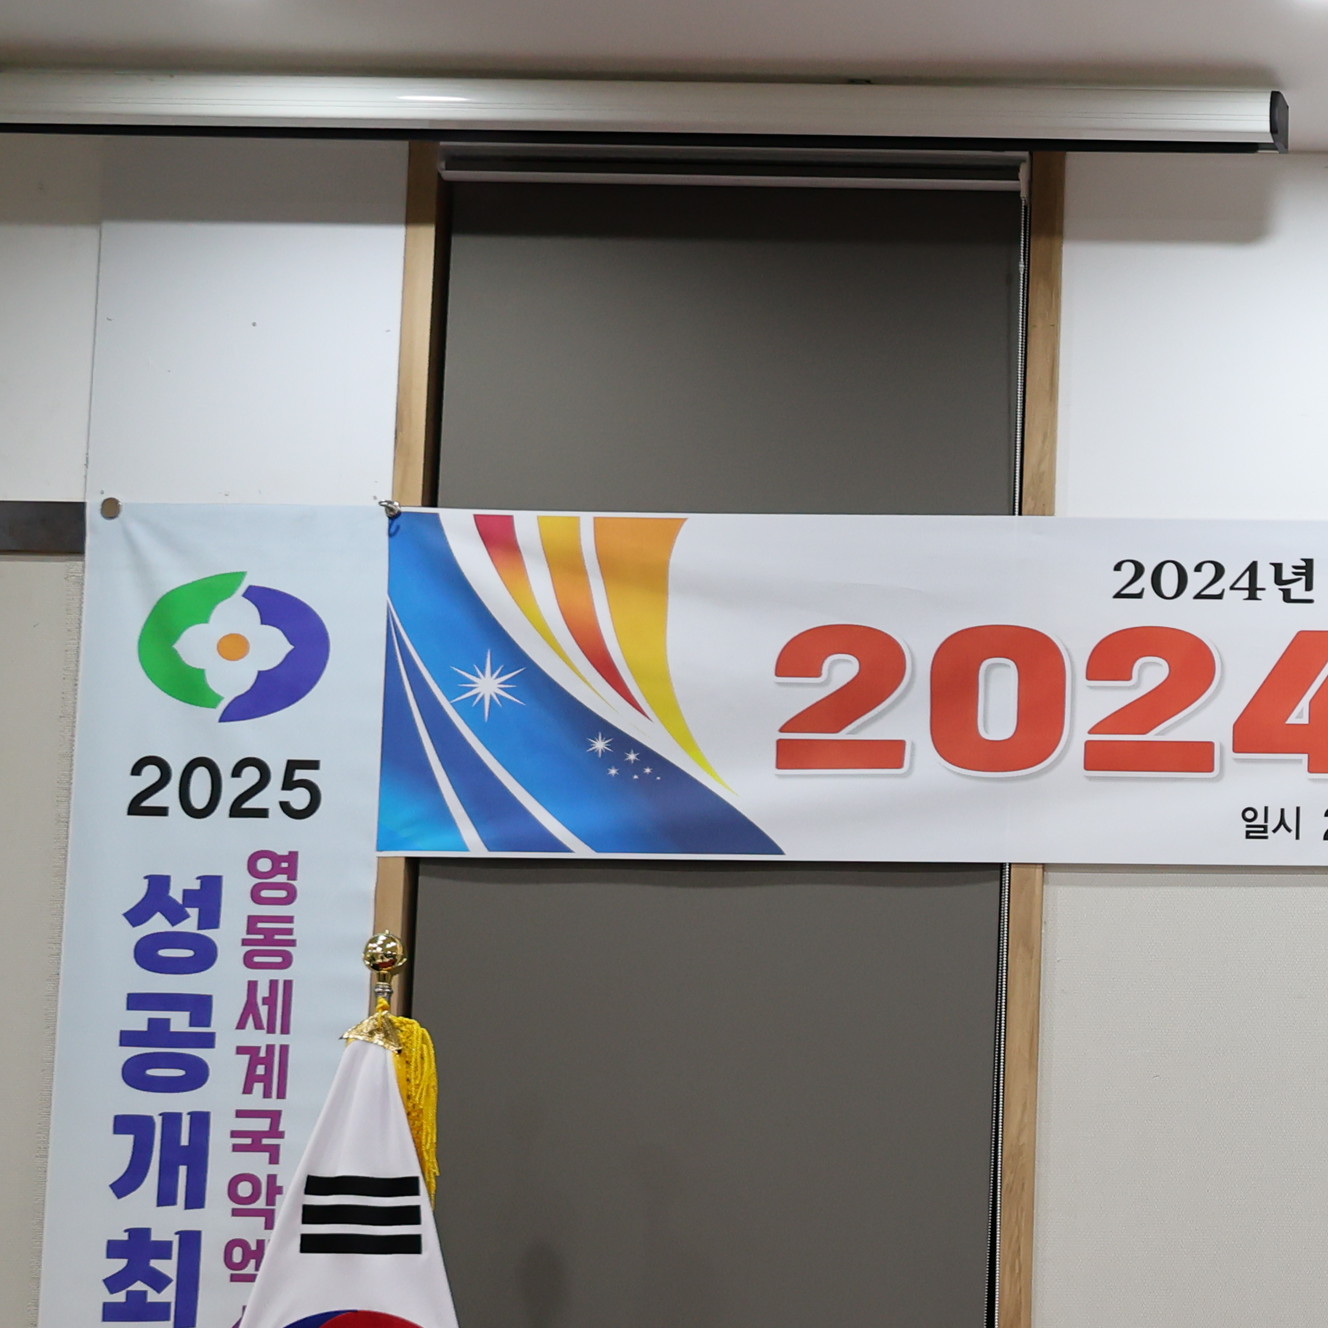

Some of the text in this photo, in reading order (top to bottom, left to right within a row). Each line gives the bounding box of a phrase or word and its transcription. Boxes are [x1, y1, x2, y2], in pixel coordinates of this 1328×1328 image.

[1113, 558, 1315, 604] 2024년
[126, 755, 322, 820] 2025
[1241, 805, 1301, 841] 일시
